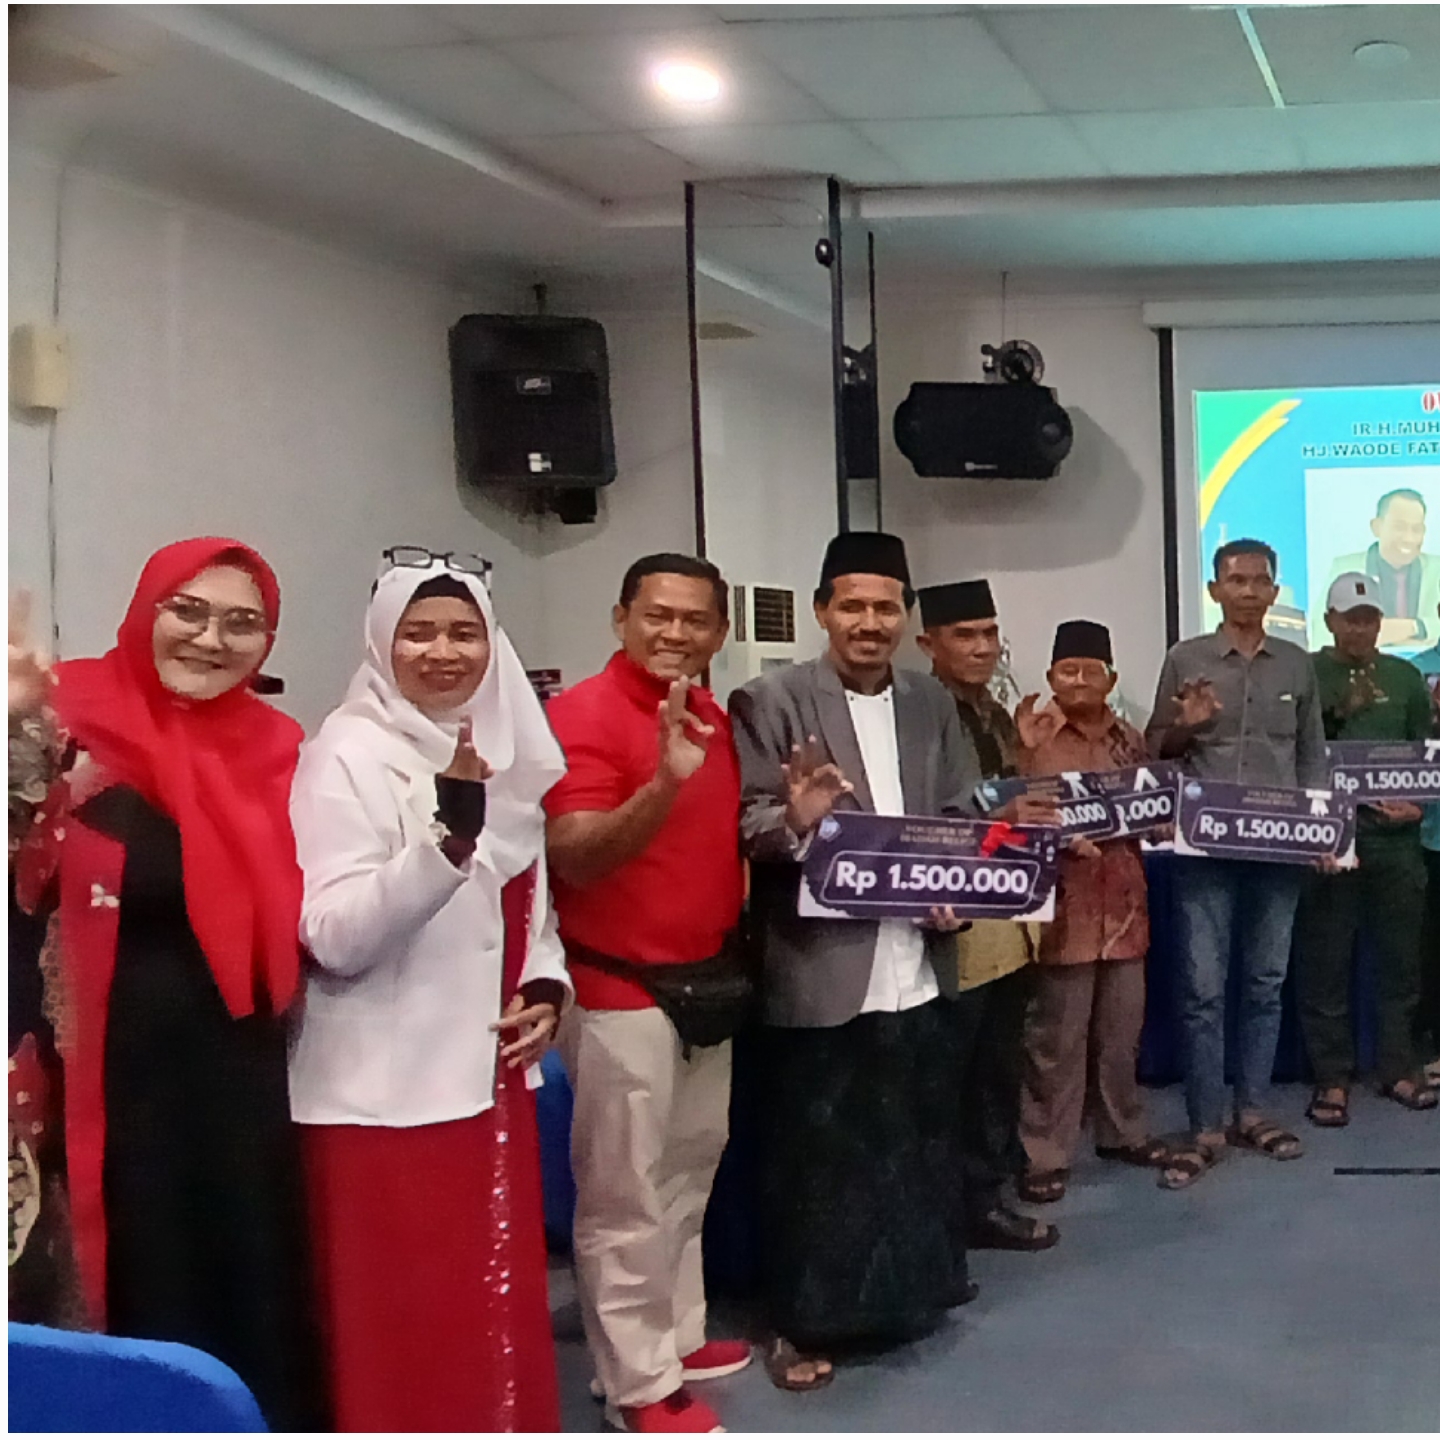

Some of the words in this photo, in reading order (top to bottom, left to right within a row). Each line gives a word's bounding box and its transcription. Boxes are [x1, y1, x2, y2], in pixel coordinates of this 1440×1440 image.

[1302, 442, 1400, 457] HJ.WAODE
[1334, 771, 1360, 794] Rp
[1199, 813, 1229, 839] Rp
[1235, 817, 1336, 844] 1.500.000
[835, 860, 878, 896] Rp
[887, 863, 1029, 894] 1.500.000
